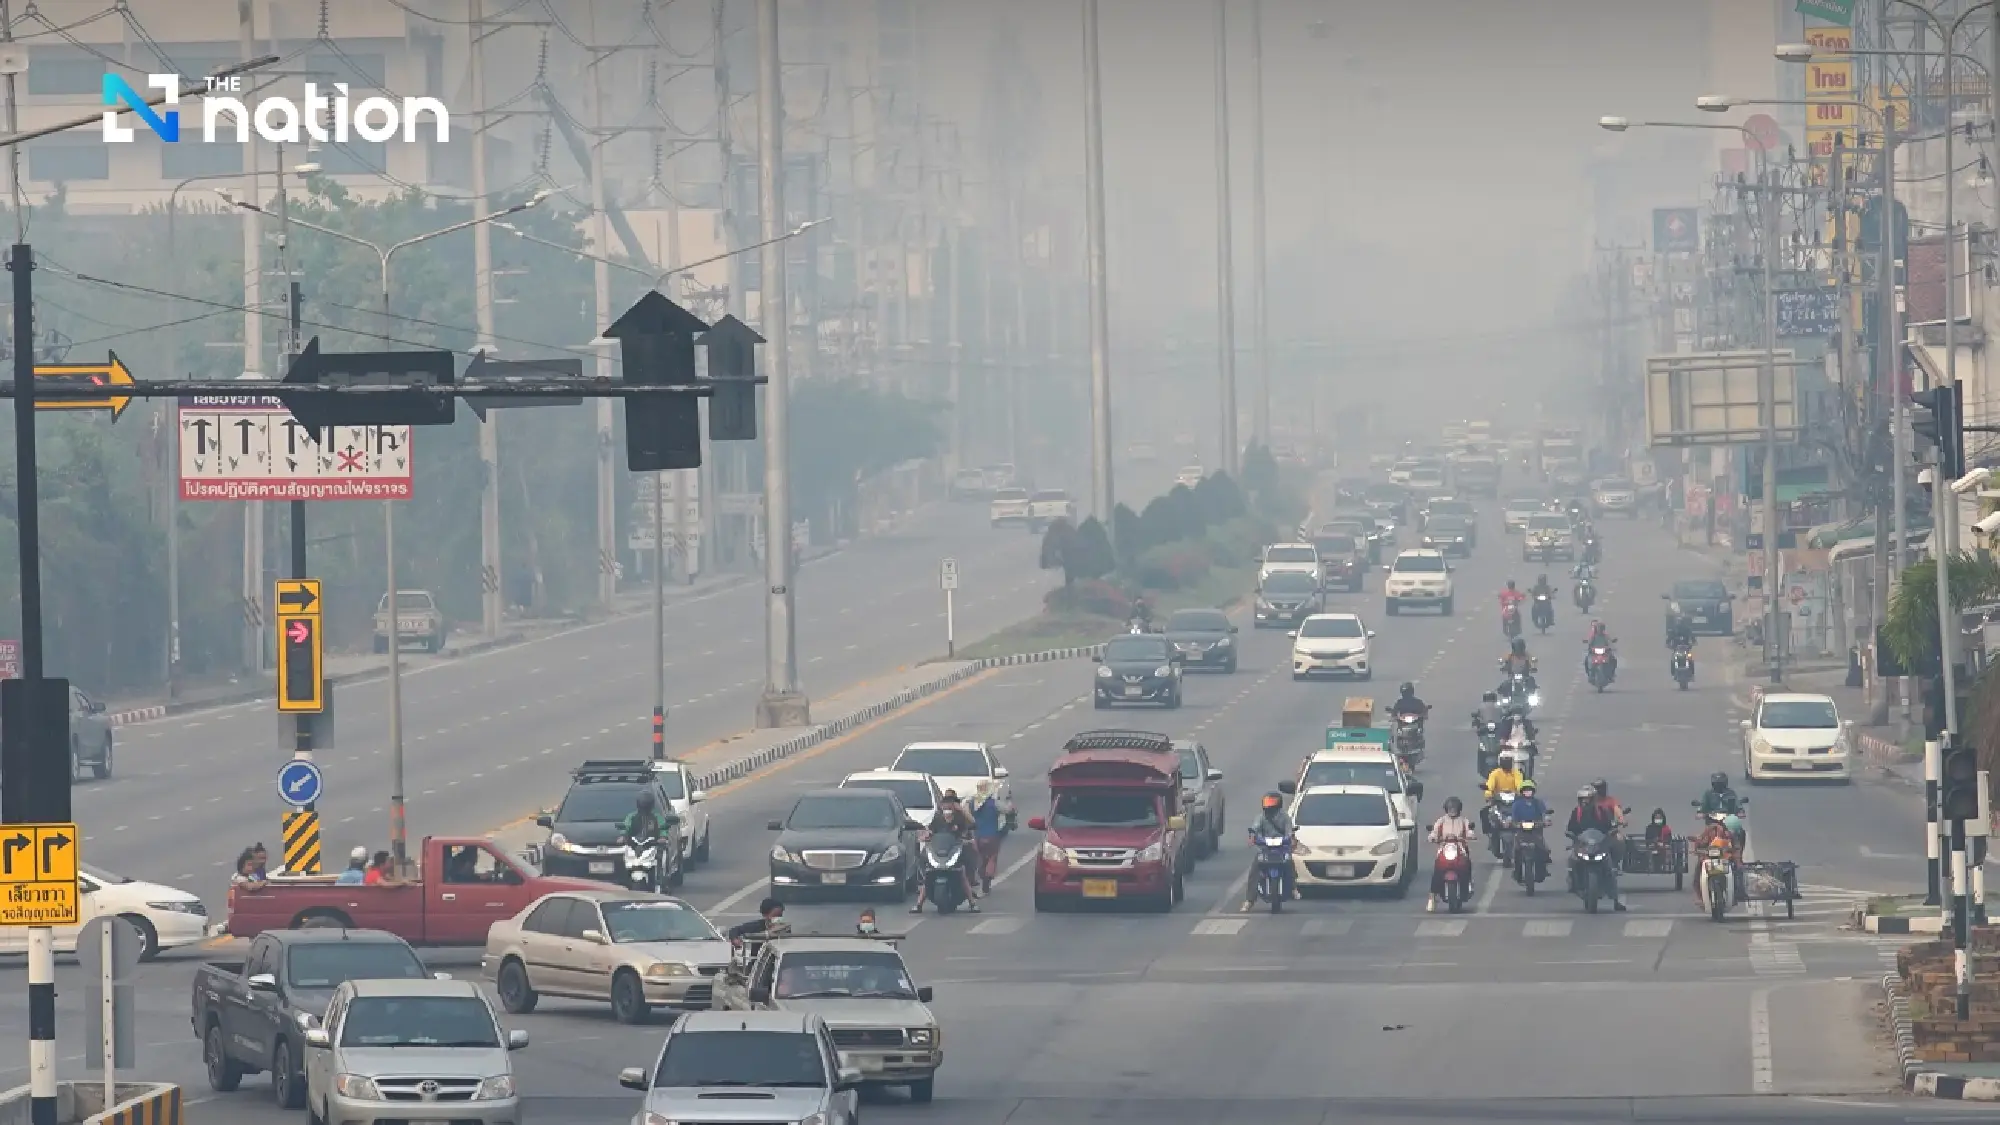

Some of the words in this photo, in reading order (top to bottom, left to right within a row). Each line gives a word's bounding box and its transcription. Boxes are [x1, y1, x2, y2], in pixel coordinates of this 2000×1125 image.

[185, 480, 408, 499] โปรดปฏิบัติตามสัญญาณไฟจราจร
[8, 883, 66, 903] เลี้ยวขวา
[2, 903, 73, 920] รอสัญญาณไฟ
